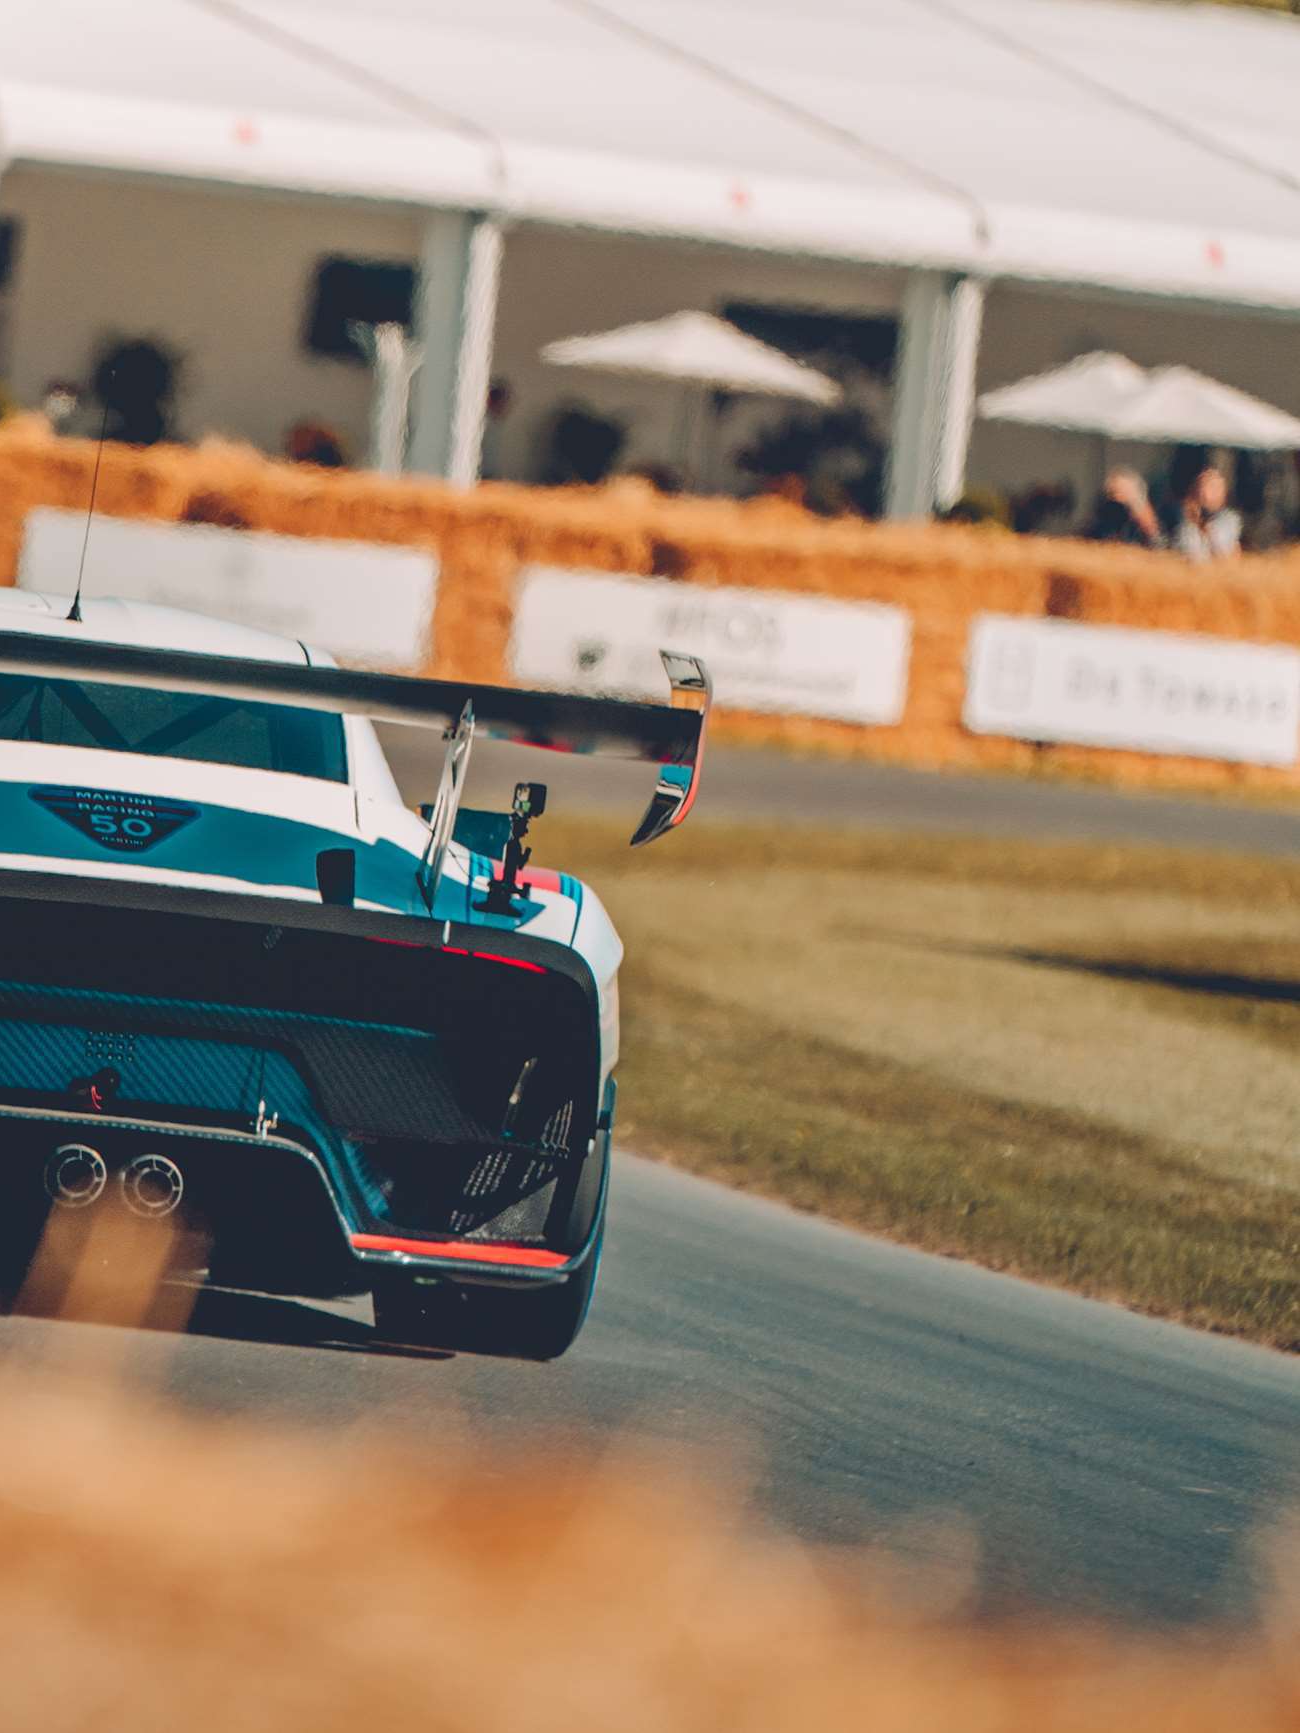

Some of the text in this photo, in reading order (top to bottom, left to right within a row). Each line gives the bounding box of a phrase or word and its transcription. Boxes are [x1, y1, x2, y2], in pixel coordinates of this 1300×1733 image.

[76, 790, 154, 806] MARTINI
[78, 802, 155, 818] RACING
[90, 813, 153, 837] 50
